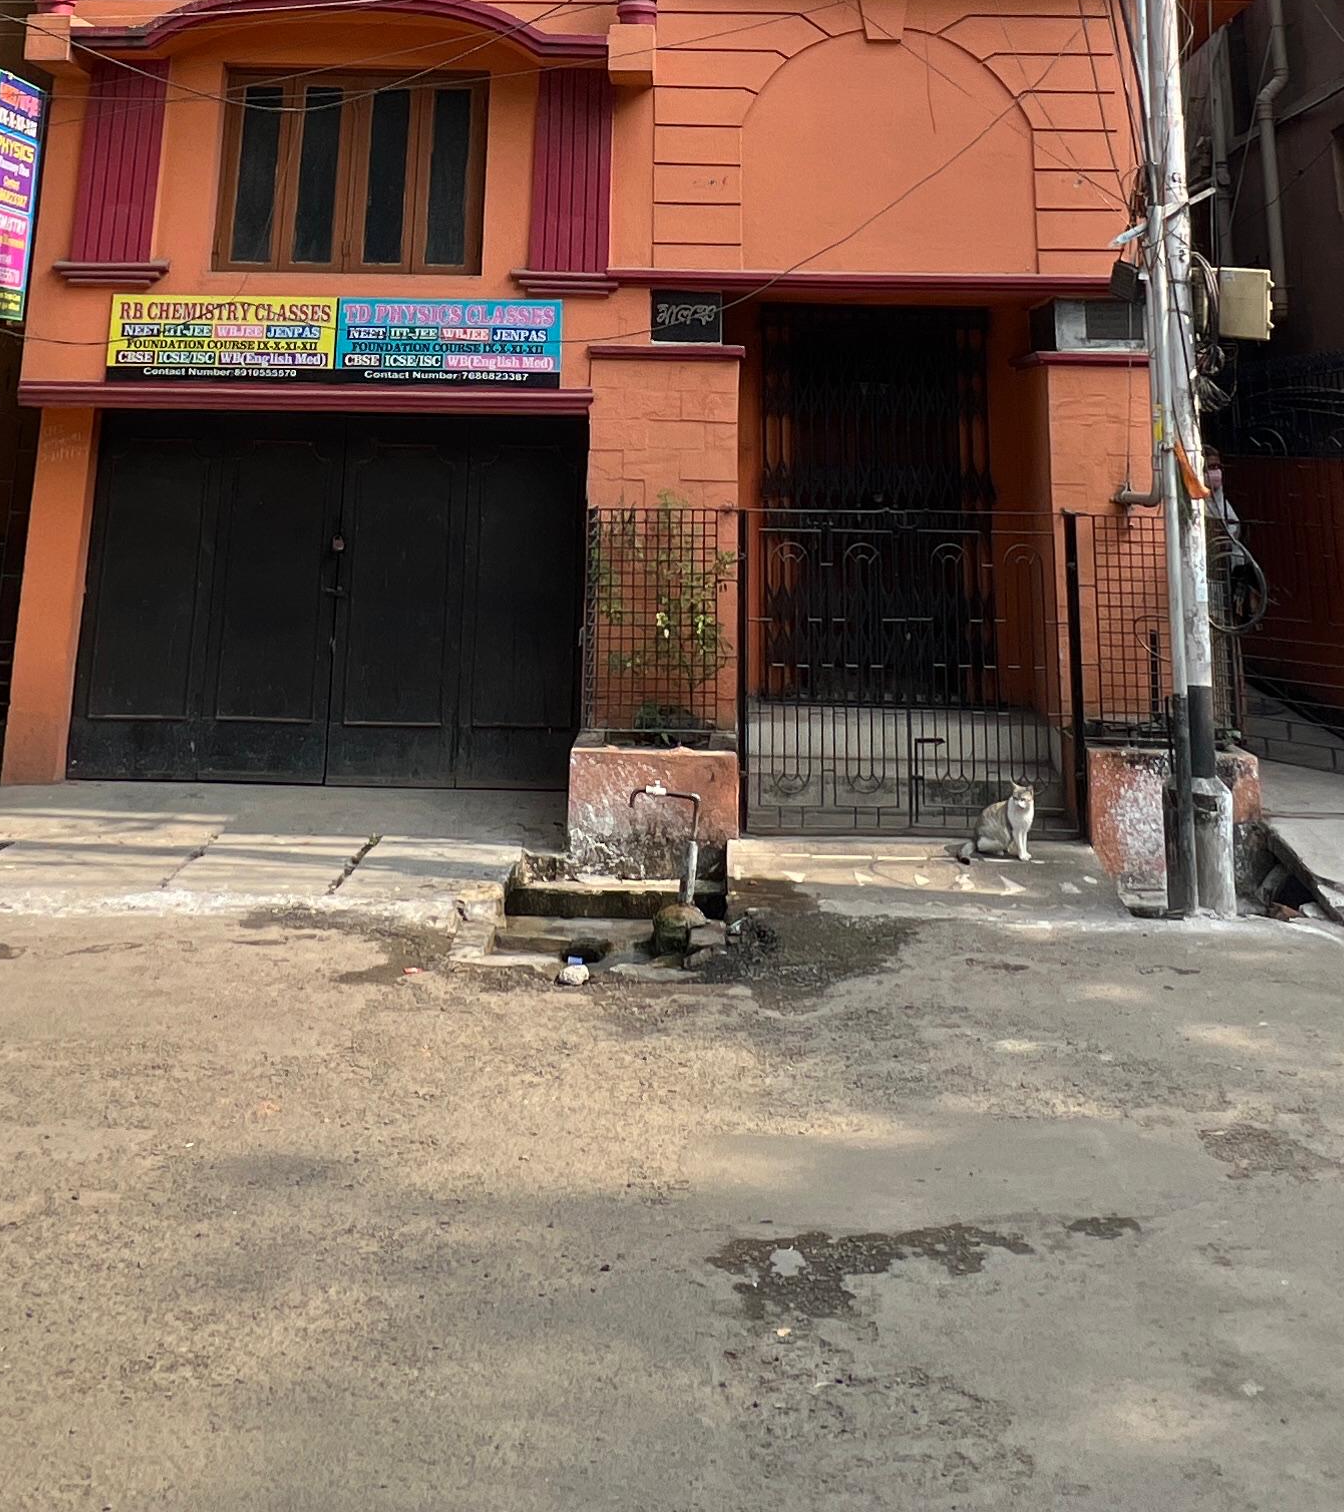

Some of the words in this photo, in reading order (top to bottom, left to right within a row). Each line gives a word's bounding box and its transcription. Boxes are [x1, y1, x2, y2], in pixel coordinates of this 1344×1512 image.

[119, 302, 143, 320] RB
[147, 302, 251, 321] CHEMISTRY
[255, 303, 331, 323] CLASSES
[344, 304, 371, 324] TD
[375, 304, 462, 325] PHYSICS
[466, 306, 555, 326] CLASSES
[123, 324, 160, 336] NEET
[164, 324, 212, 337] IIT-JEE
[217, 325, 263, 338] WBJEE
[266, 325, 321, 338] JENPAS
[348, 327, 386, 339] NEET
[389, 328, 438, 340] IIT-JEE
[442, 328, 489, 341] WBJEE
[493, 328, 546, 342] JENPAS
[127, 338, 205, 350] FOUNDATION
[207, 340, 255, 351] COURSE
[256, 341, 318, 352] IX-X-XI-XII
[352, 342, 431, 353] FOUNDATION
[433, 343, 481, 354] COURSE
[482, 344, 544, 355] IX-X-XI-XII
[118, 351, 153, 363] CBSE
[158, 352, 215, 364] ICSE/ISC
[344, 354, 380, 366] CBSE
[384, 355, 441, 367] ICSE/ISC
[143, 367, 186, 376] Contact
[364, 370, 409, 380] Contact
